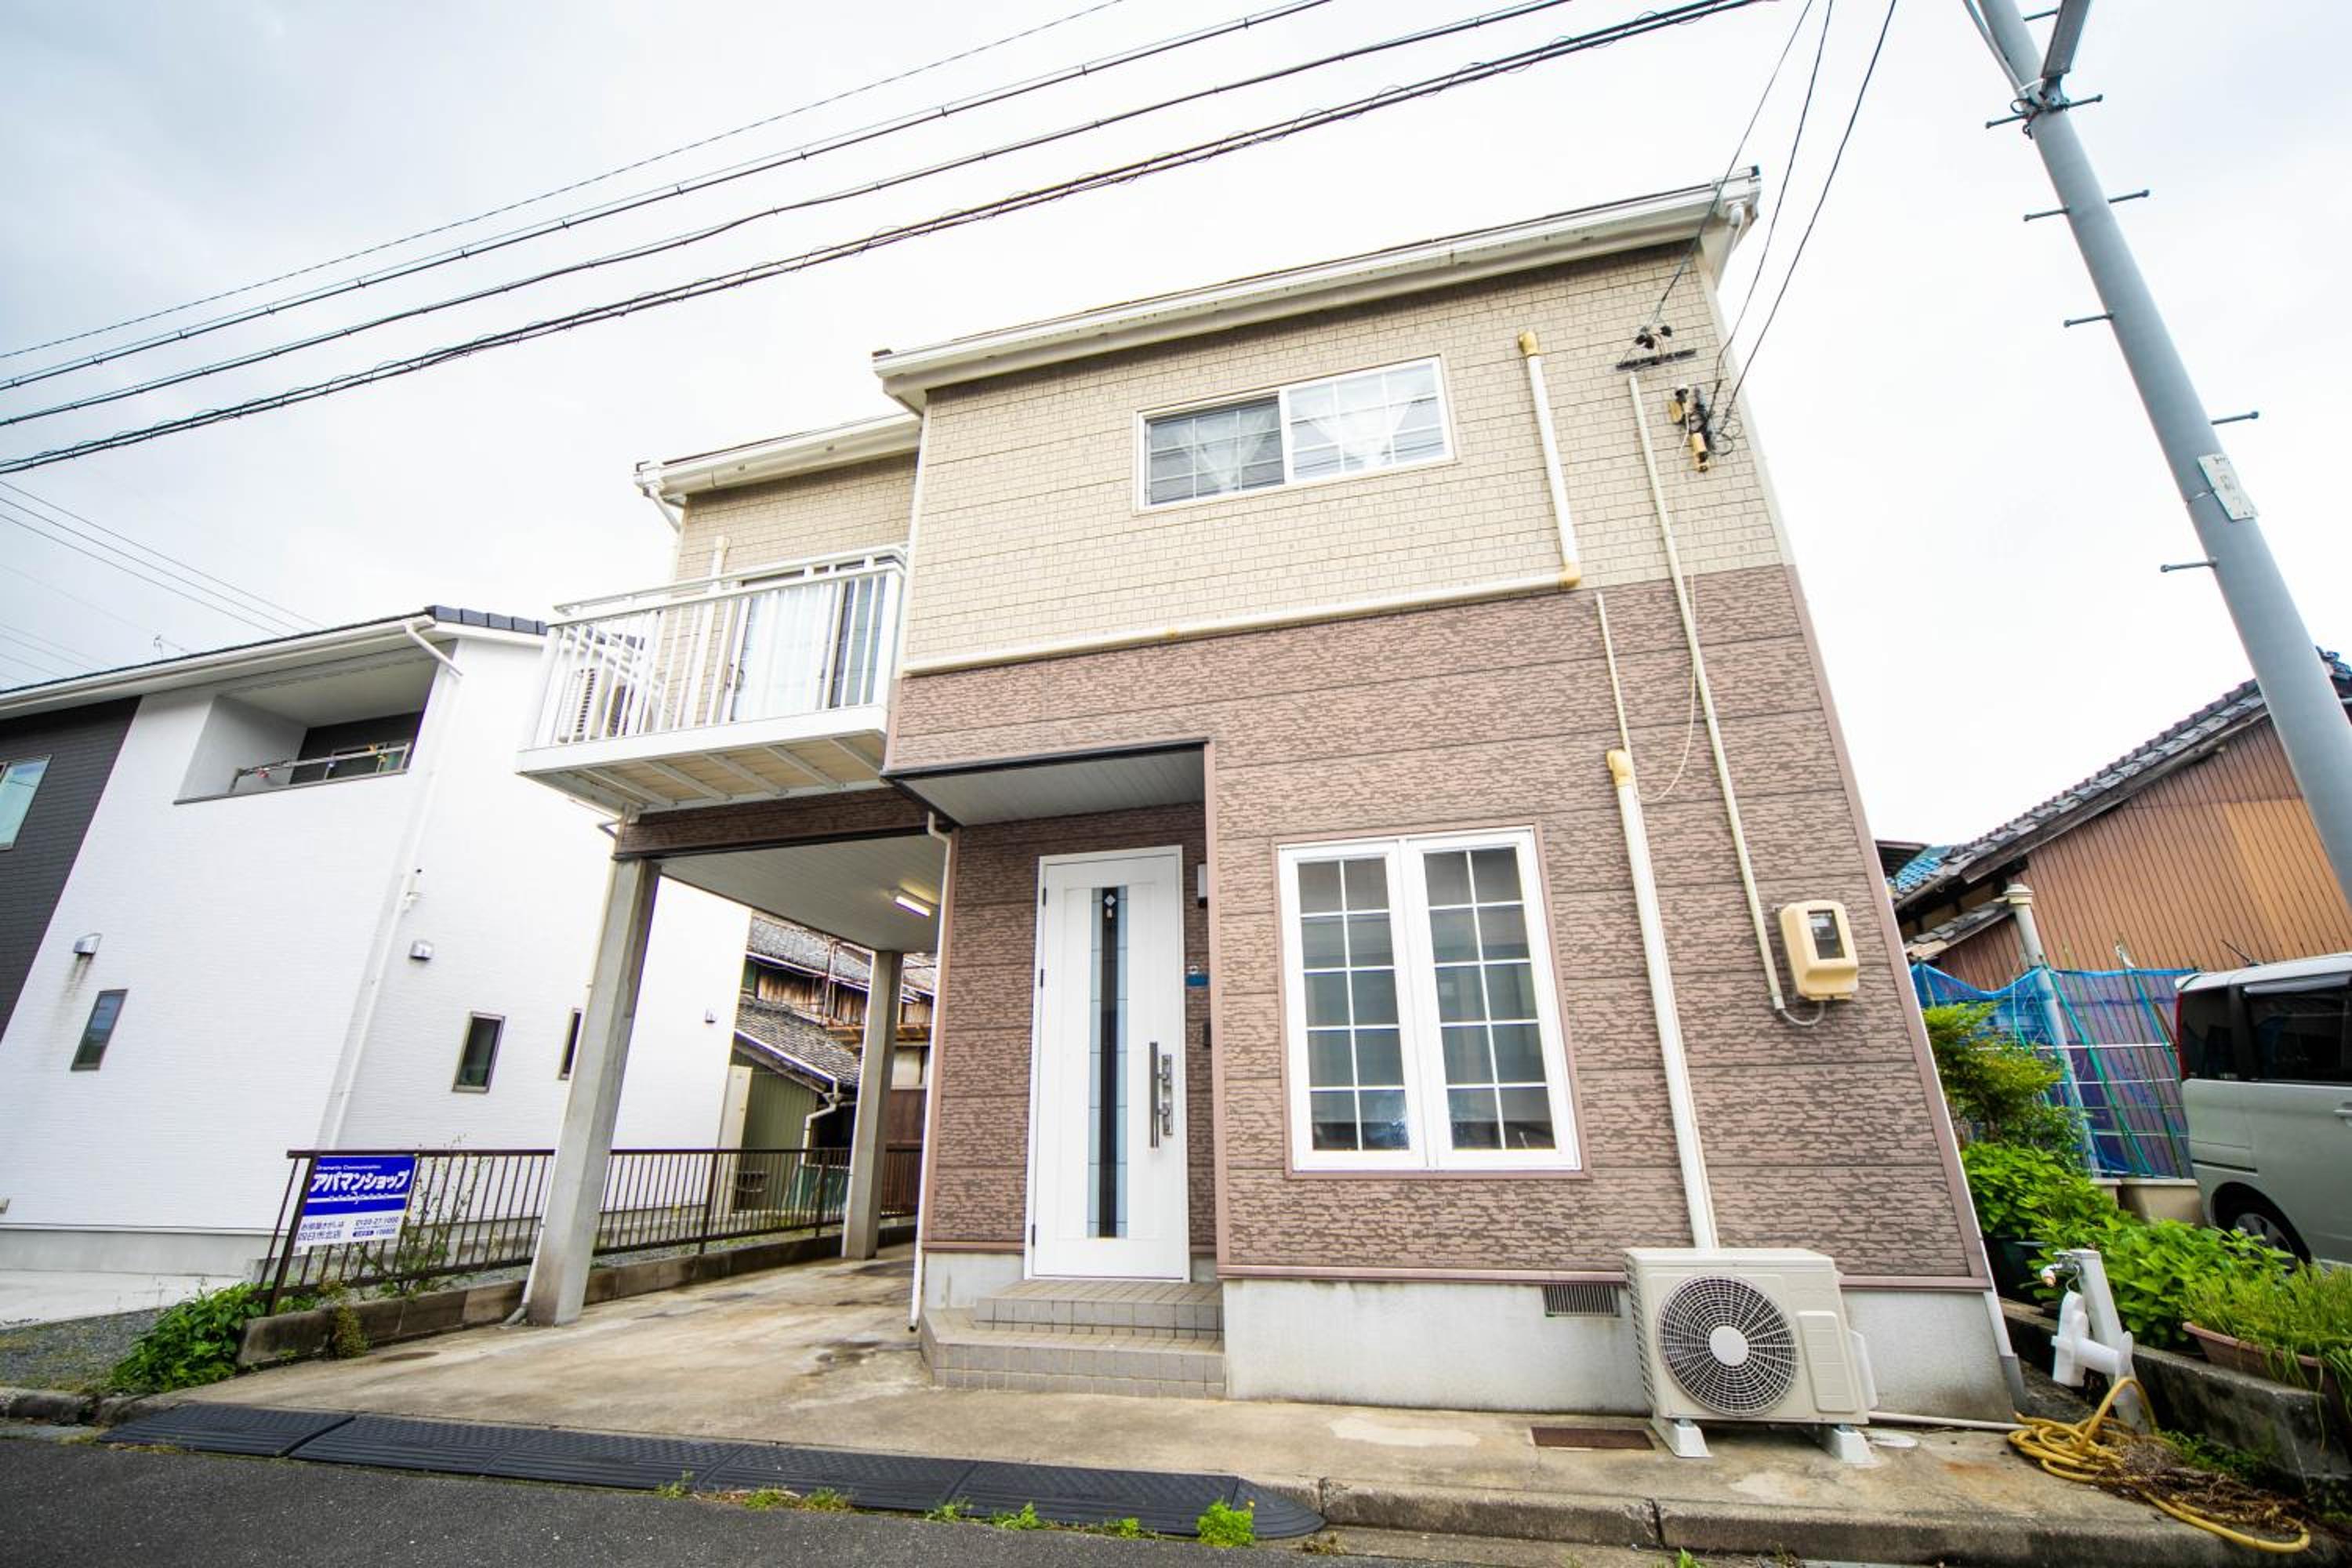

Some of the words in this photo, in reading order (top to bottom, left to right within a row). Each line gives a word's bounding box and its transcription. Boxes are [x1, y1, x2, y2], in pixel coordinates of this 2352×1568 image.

[310, 1169, 410, 1192] アパマンショップ
